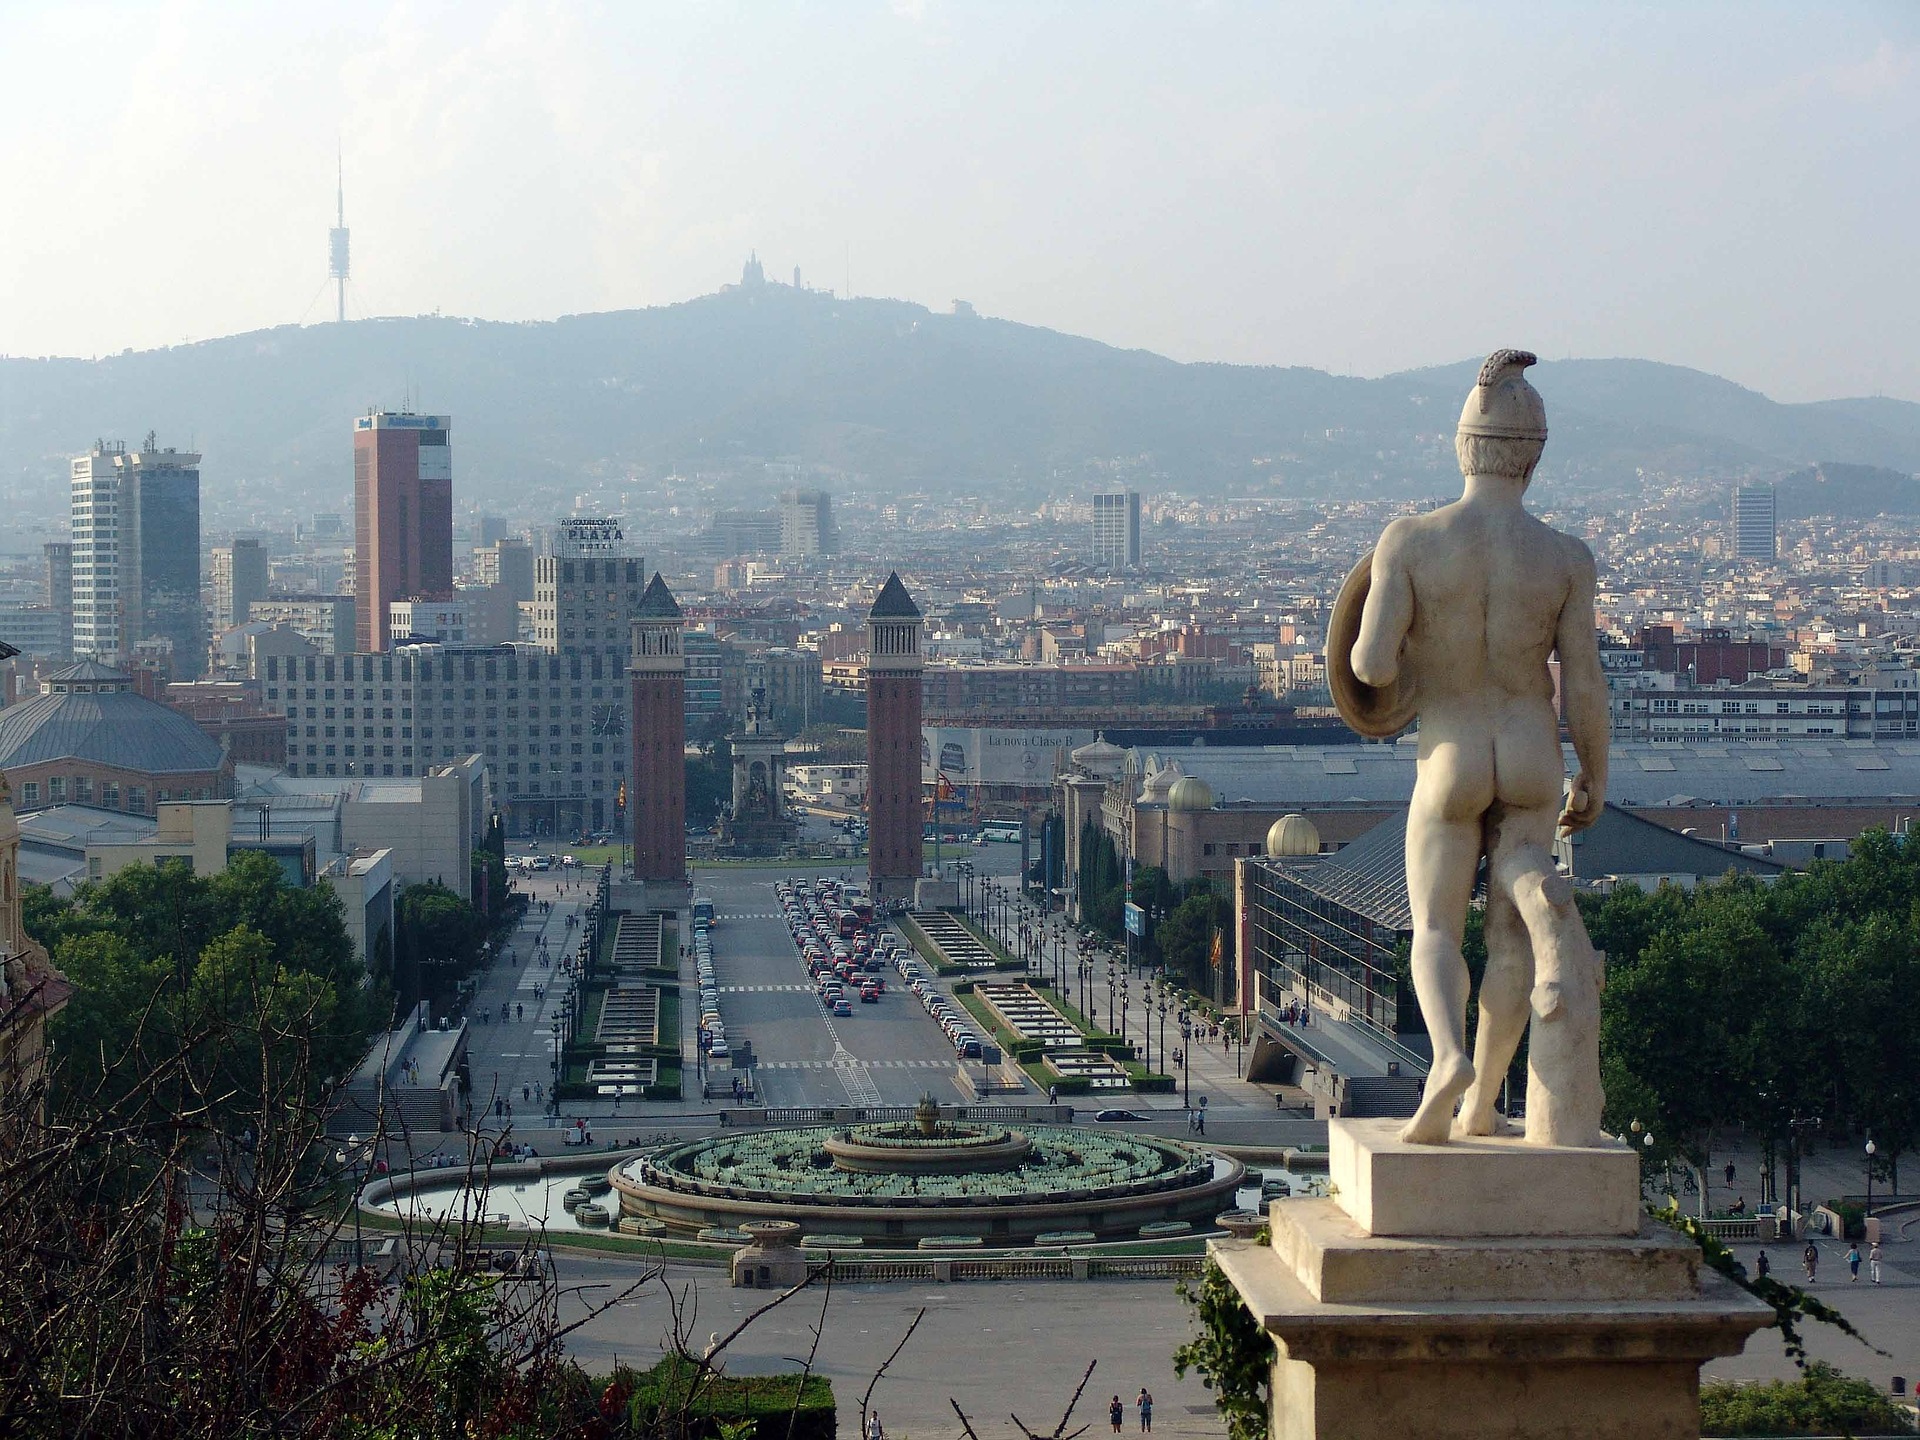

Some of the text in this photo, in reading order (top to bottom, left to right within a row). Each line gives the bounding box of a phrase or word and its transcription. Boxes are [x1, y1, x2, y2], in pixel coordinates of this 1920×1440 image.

[568, 530, 624, 540] PLAZA
[989, 735, 1073, 746] La nova Clase B
[701, 1031, 712, 1043] P
